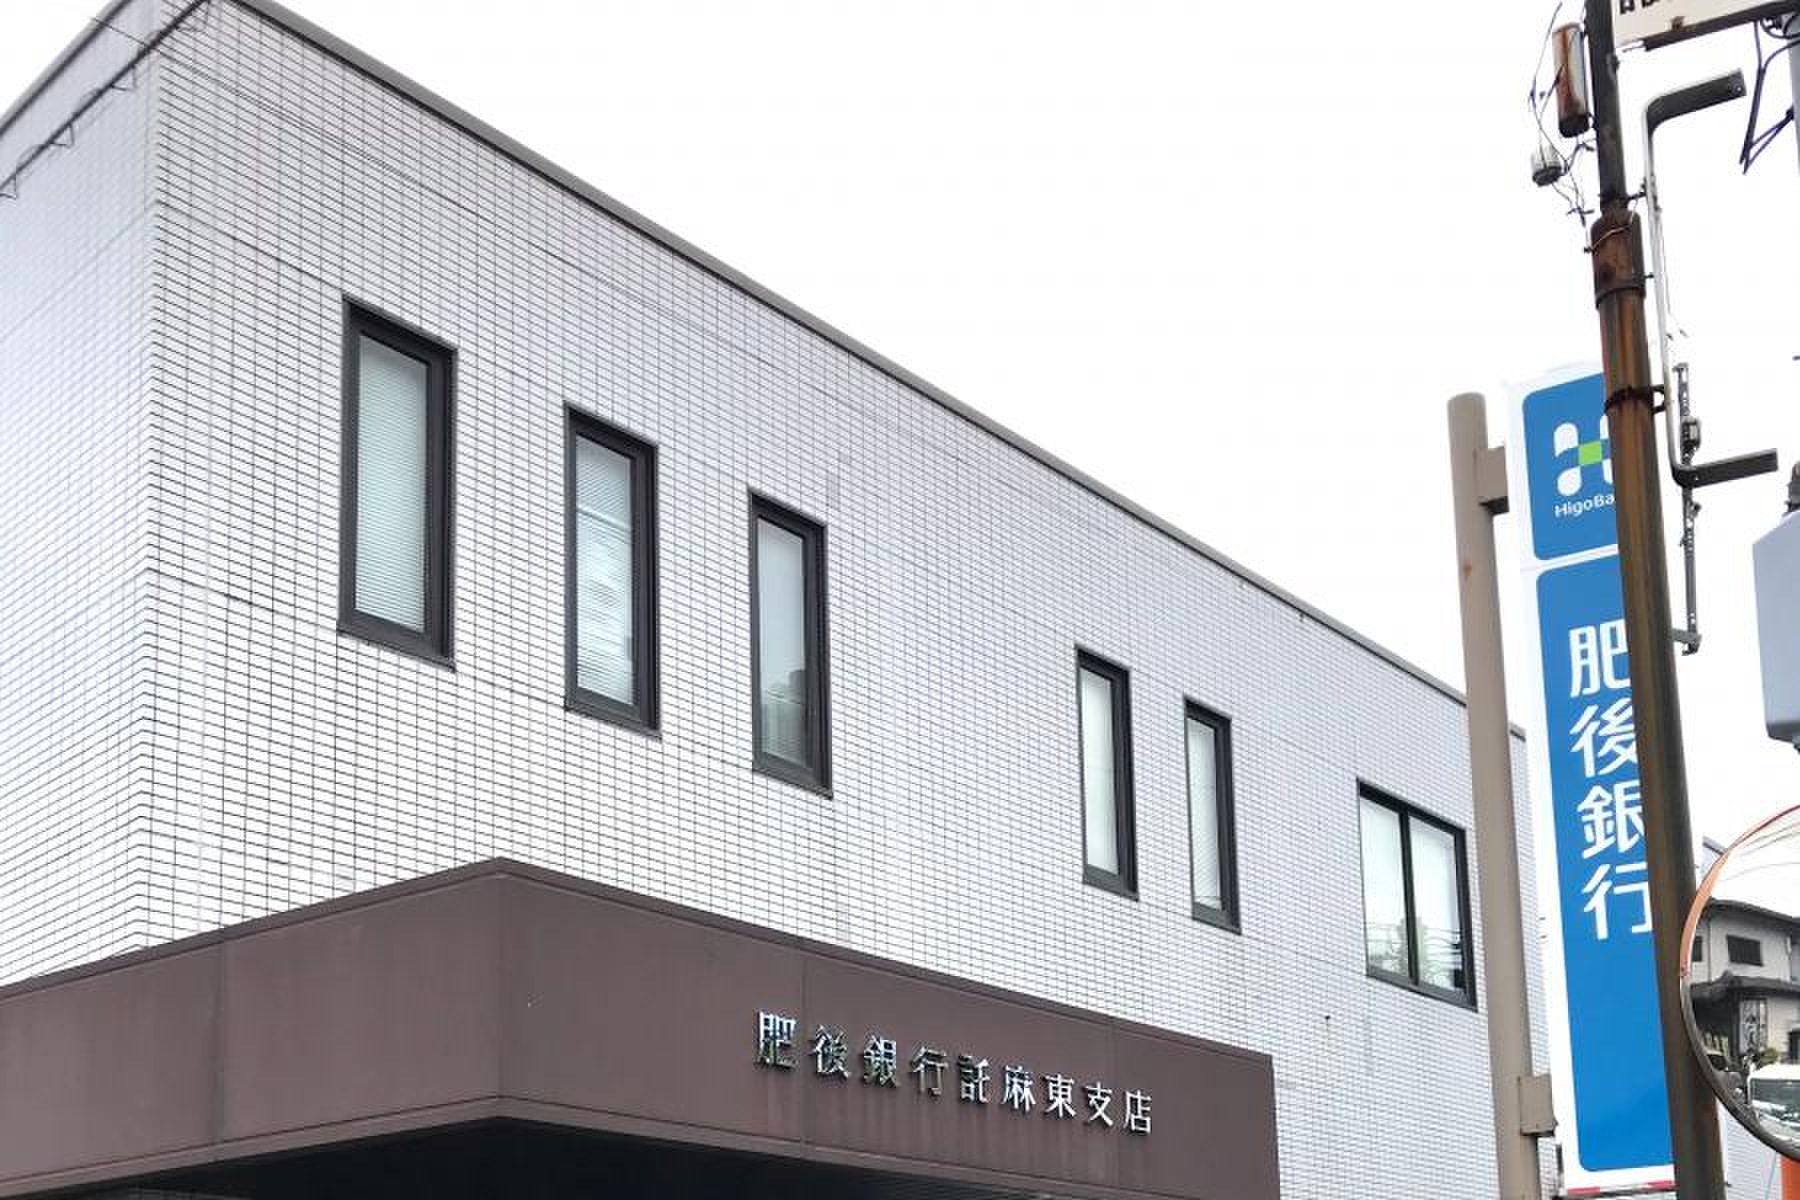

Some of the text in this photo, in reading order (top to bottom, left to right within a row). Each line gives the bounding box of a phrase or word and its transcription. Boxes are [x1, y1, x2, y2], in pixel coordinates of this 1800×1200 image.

[1554, 494, 1615, 518] HigoBa
[1568, 618, 1653, 940] 肥後銀行
[754, 1011, 1152, 1135] 肥後銀行託麻東支店
